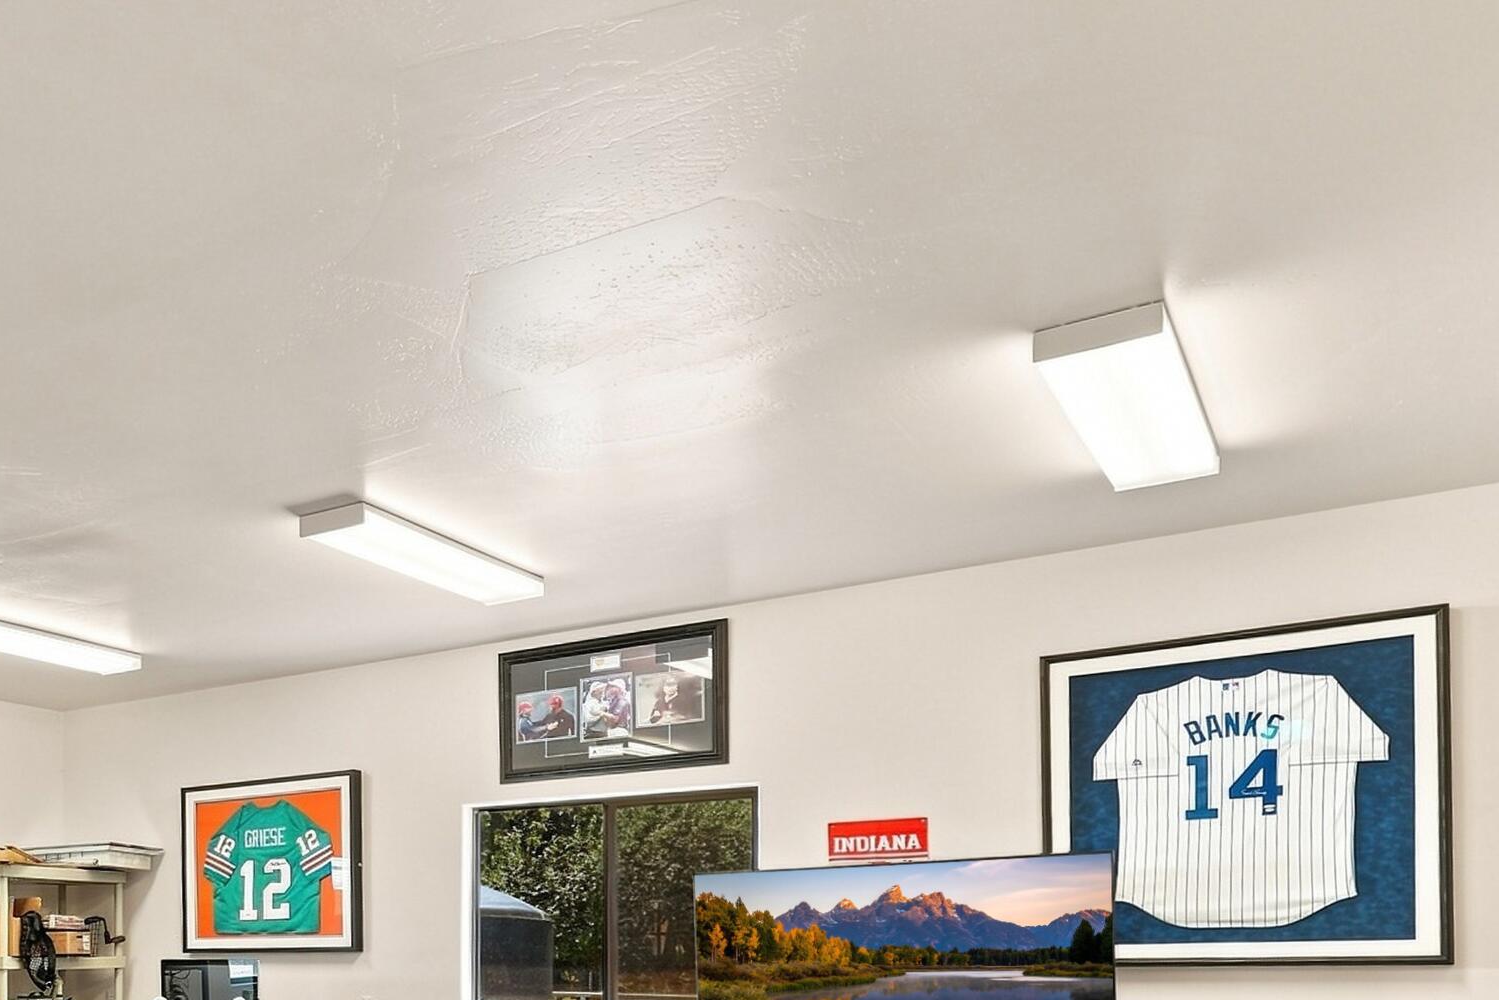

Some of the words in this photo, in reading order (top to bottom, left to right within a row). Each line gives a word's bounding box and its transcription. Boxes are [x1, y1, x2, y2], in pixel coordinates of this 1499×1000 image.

[1183, 712, 1285, 746] BANKS
[1185, 748, 1284, 820] 14
[213, 834, 236, 859] 12
[244, 827, 287, 849] GRIESE
[296, 829, 320, 857] 12
[832, 833, 923, 853] INDIANA
[239, 858, 292, 921] 12
